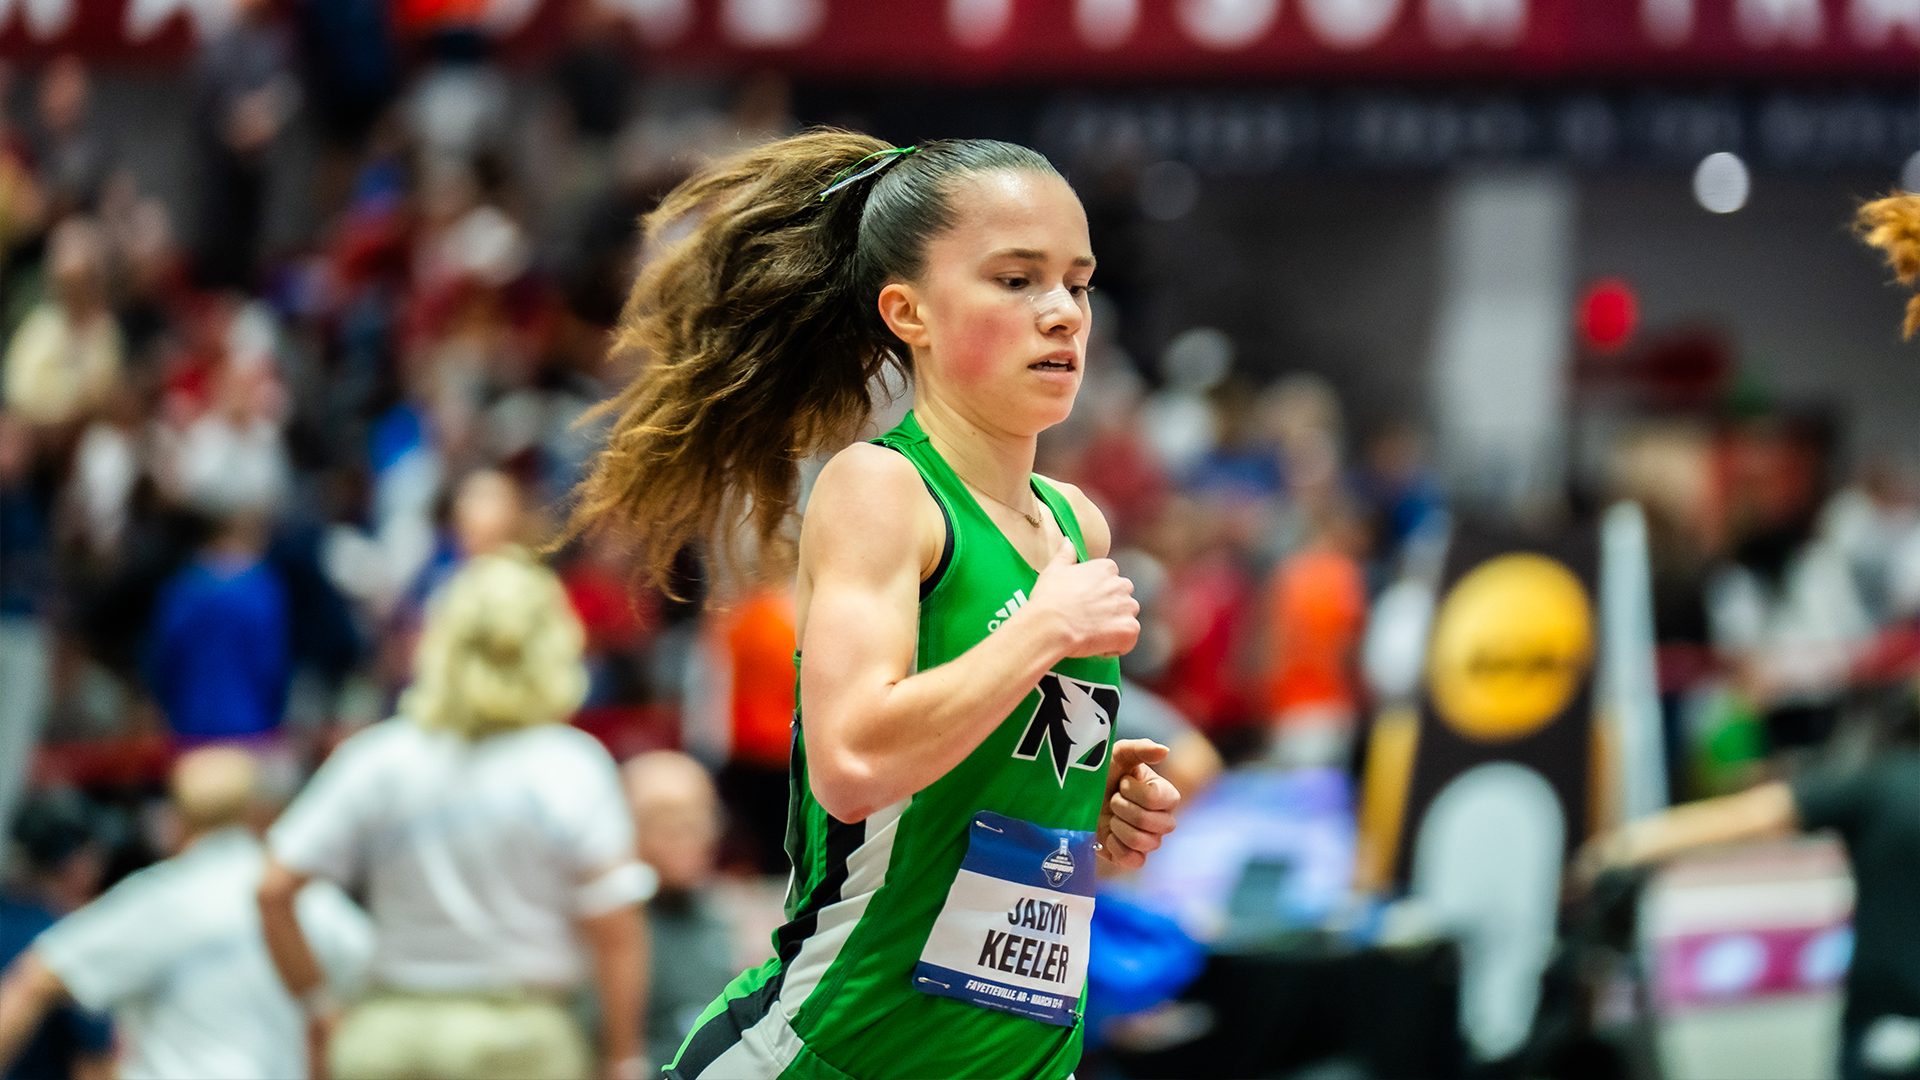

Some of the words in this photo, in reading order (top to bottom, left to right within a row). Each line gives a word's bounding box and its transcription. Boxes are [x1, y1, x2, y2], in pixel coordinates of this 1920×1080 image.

[1007, 897, 1068, 935] JADYN
[977, 929, 1069, 984] KEELER
[965, 979, 1017, 1001] FAYETTEVILLE,
[1016, 991, 1028, 1003] AR
[1030, 994, 1053, 1007] MARCH
